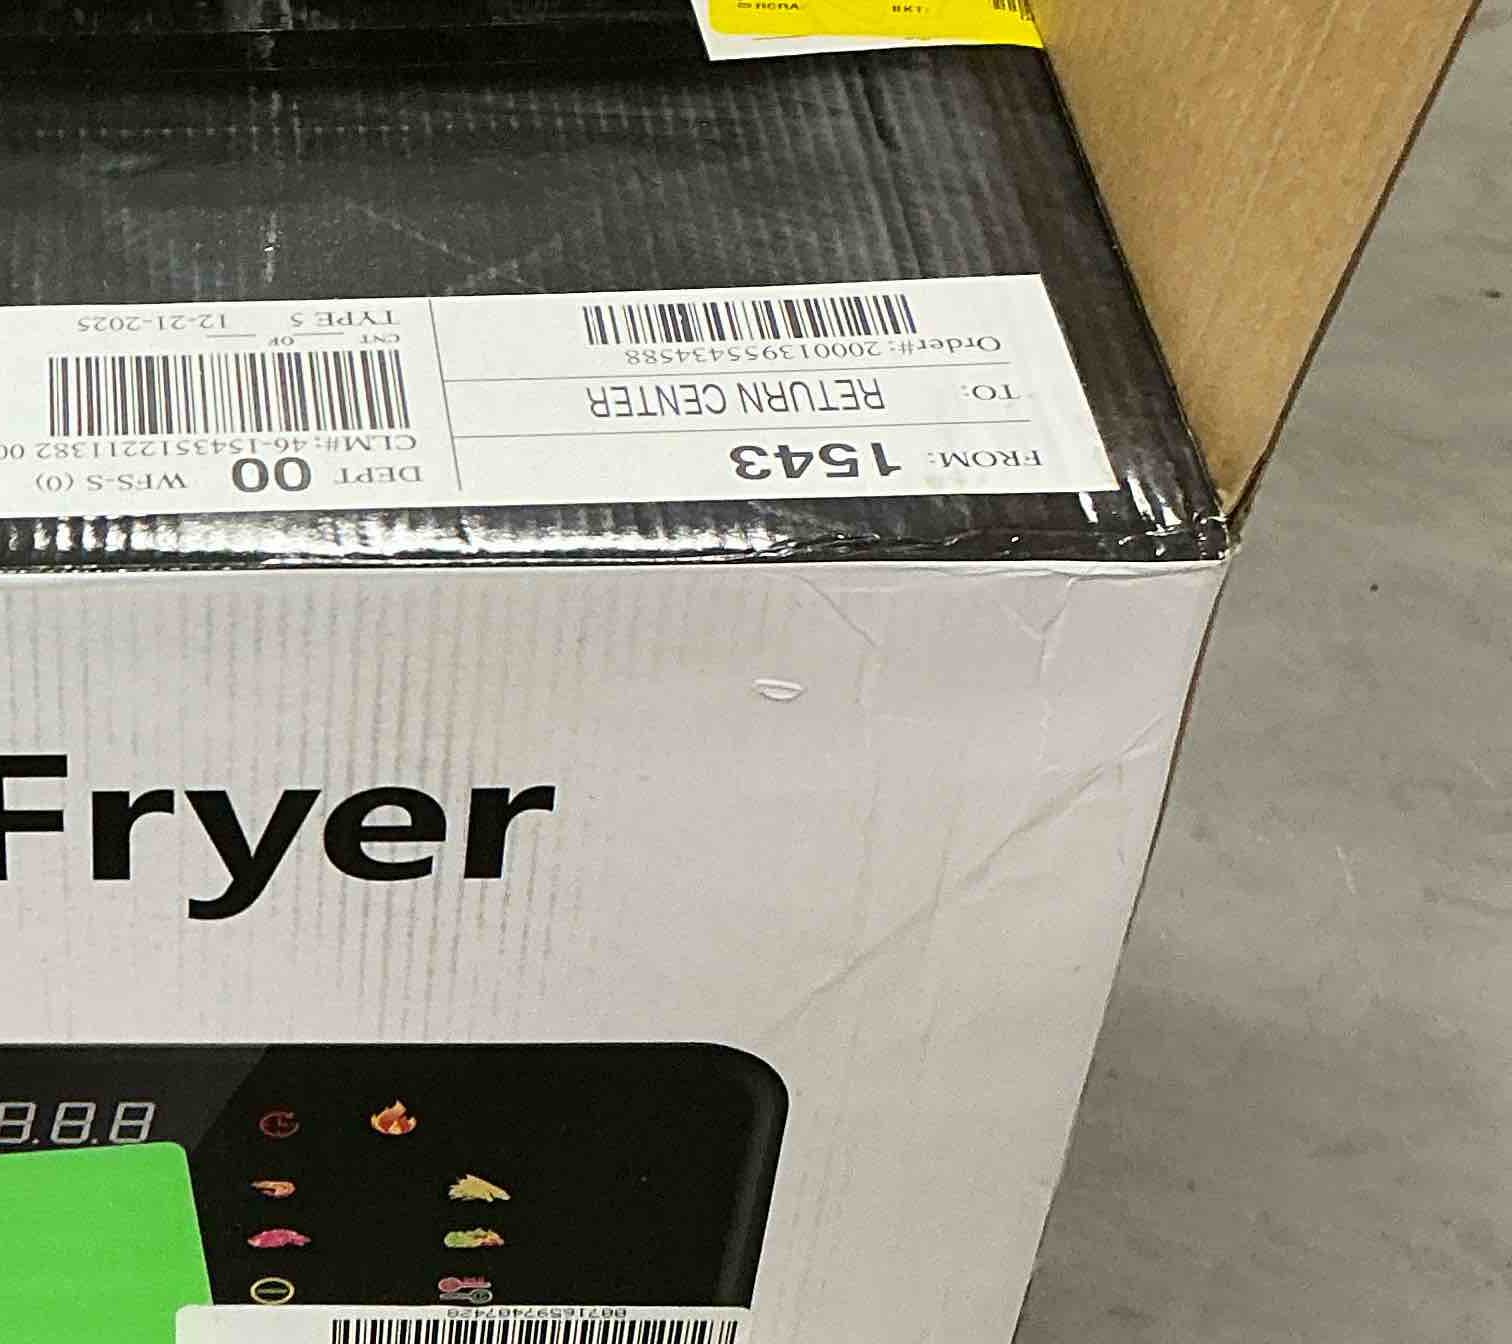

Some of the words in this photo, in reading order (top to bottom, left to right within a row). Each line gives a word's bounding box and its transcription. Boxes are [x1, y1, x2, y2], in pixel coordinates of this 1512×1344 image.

[76, 314, 227, 332] 12-21-2025
[291, 313, 303, 328] 5
[316, 309, 400, 326] TYPE
[890, 335, 1002, 356] Order#:
[585, 382, 728, 418] CENTER
[736, 377, 887, 414] RETURN
[960, 383, 1022, 402] TO:
[314, 434, 417, 451] CLM#:
[728, 441, 902, 480] 1543
[927, 449, 1044, 470] FROM:
[35, 473, 75, 492] (0)
[86, 472, 188, 491] WFS-S
[232, 457, 313, 493] 00
[336, 464, 424, 485] DEPT
